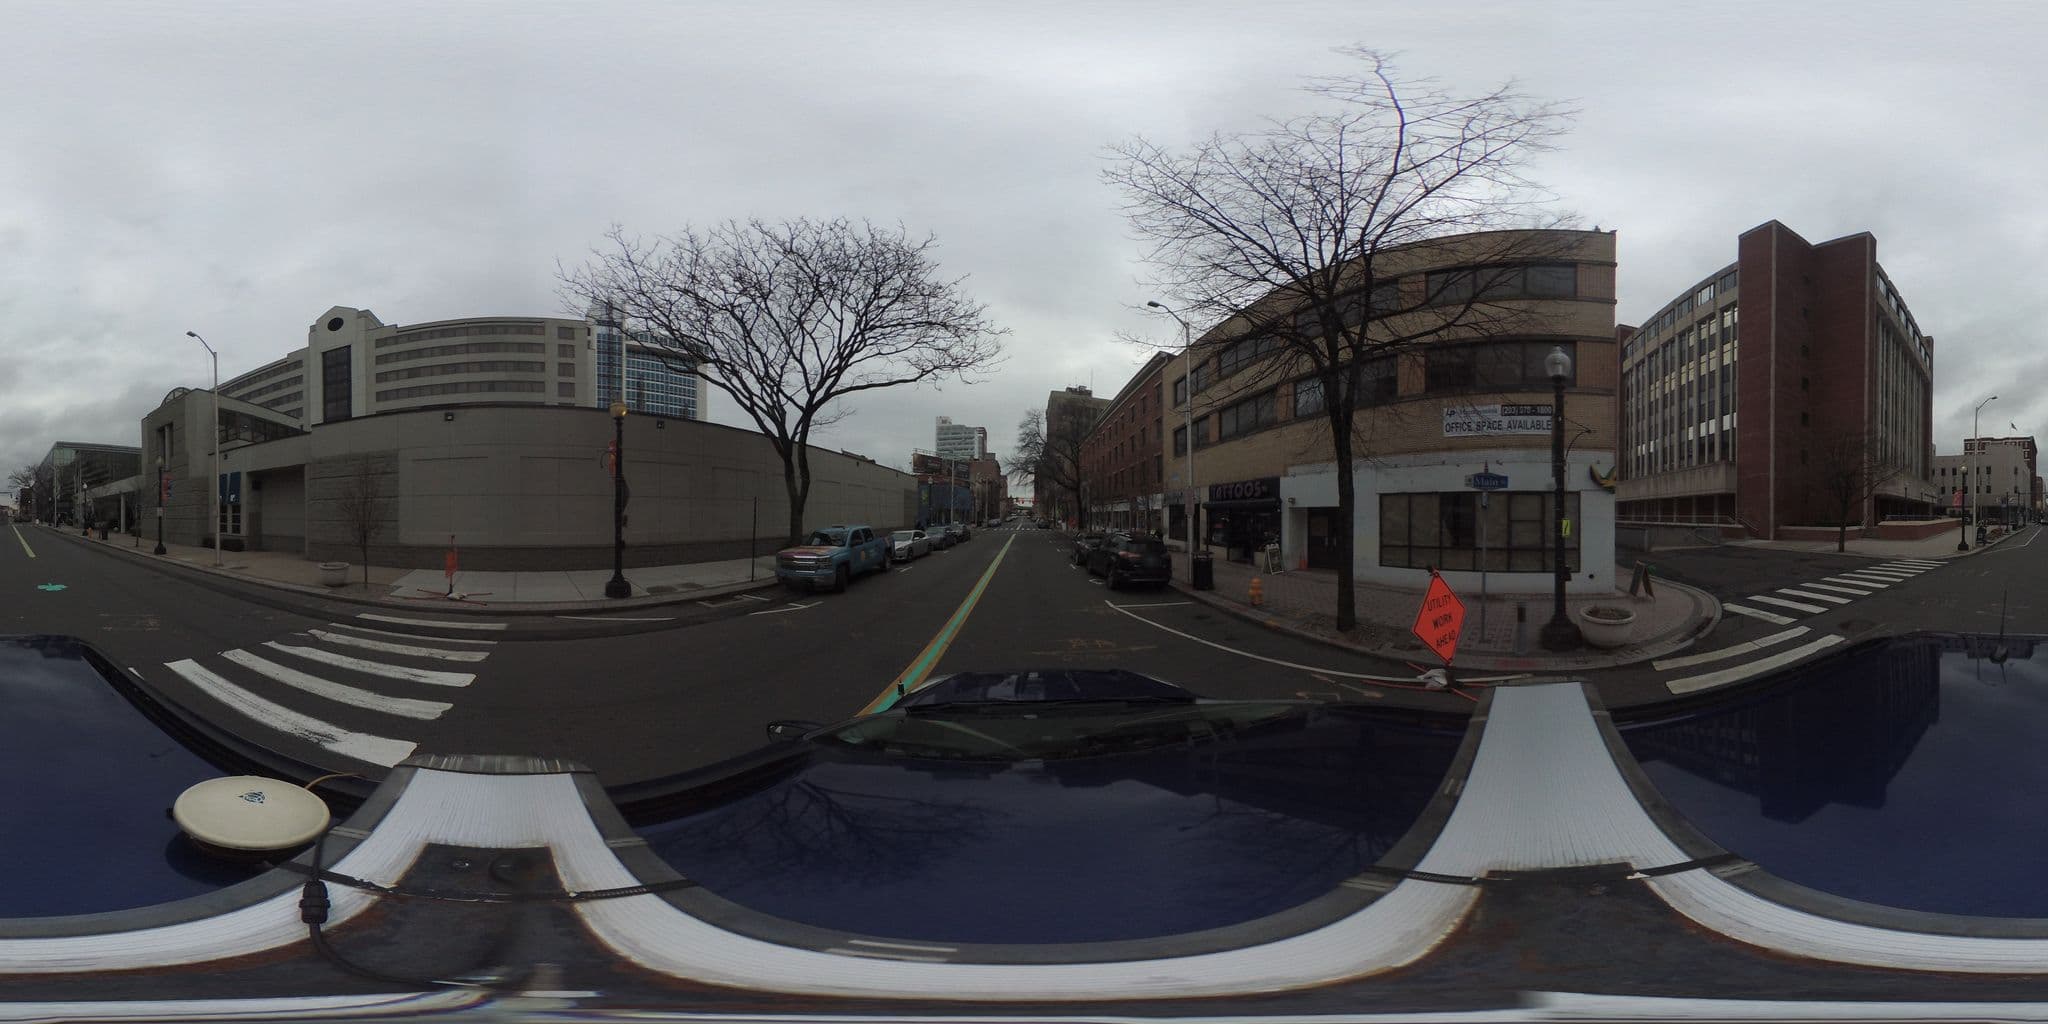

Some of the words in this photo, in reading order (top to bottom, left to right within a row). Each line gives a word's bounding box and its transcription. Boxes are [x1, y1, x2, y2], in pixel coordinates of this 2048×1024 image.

[1445, 421, 1473, 433] OFFICE
[1475, 420, 1503, 432] SPACE
[1507, 419, 1552, 431] AVAILABLE
[1427, 593, 1451, 611] UTILITY
[1432, 614, 1453, 629] WORK
[1436, 629, 1456, 648] AHEAD
